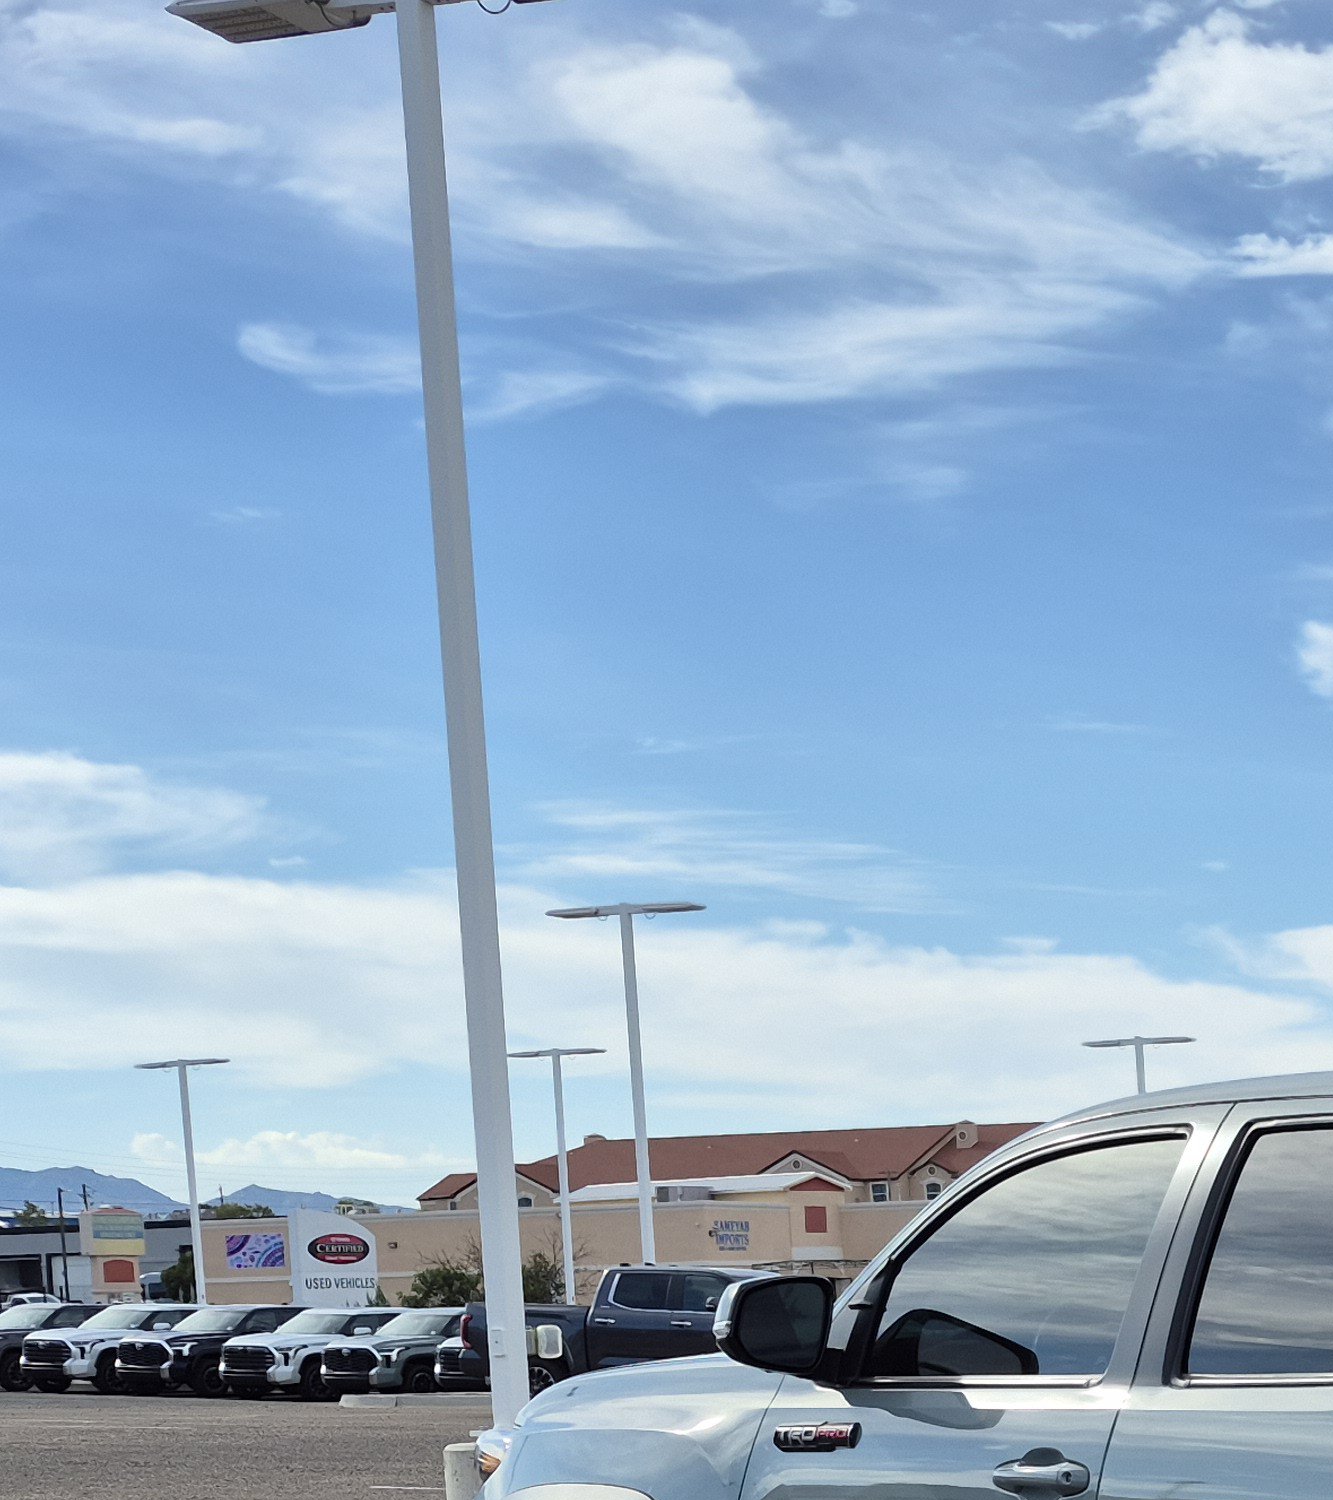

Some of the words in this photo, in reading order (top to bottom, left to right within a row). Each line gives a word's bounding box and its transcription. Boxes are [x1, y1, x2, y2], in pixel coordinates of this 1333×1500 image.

[305, 1277, 332, 1290] USED
[333, 1277, 376, 1289] VEHICLES
[775, 1426, 817, 1447] TRD
